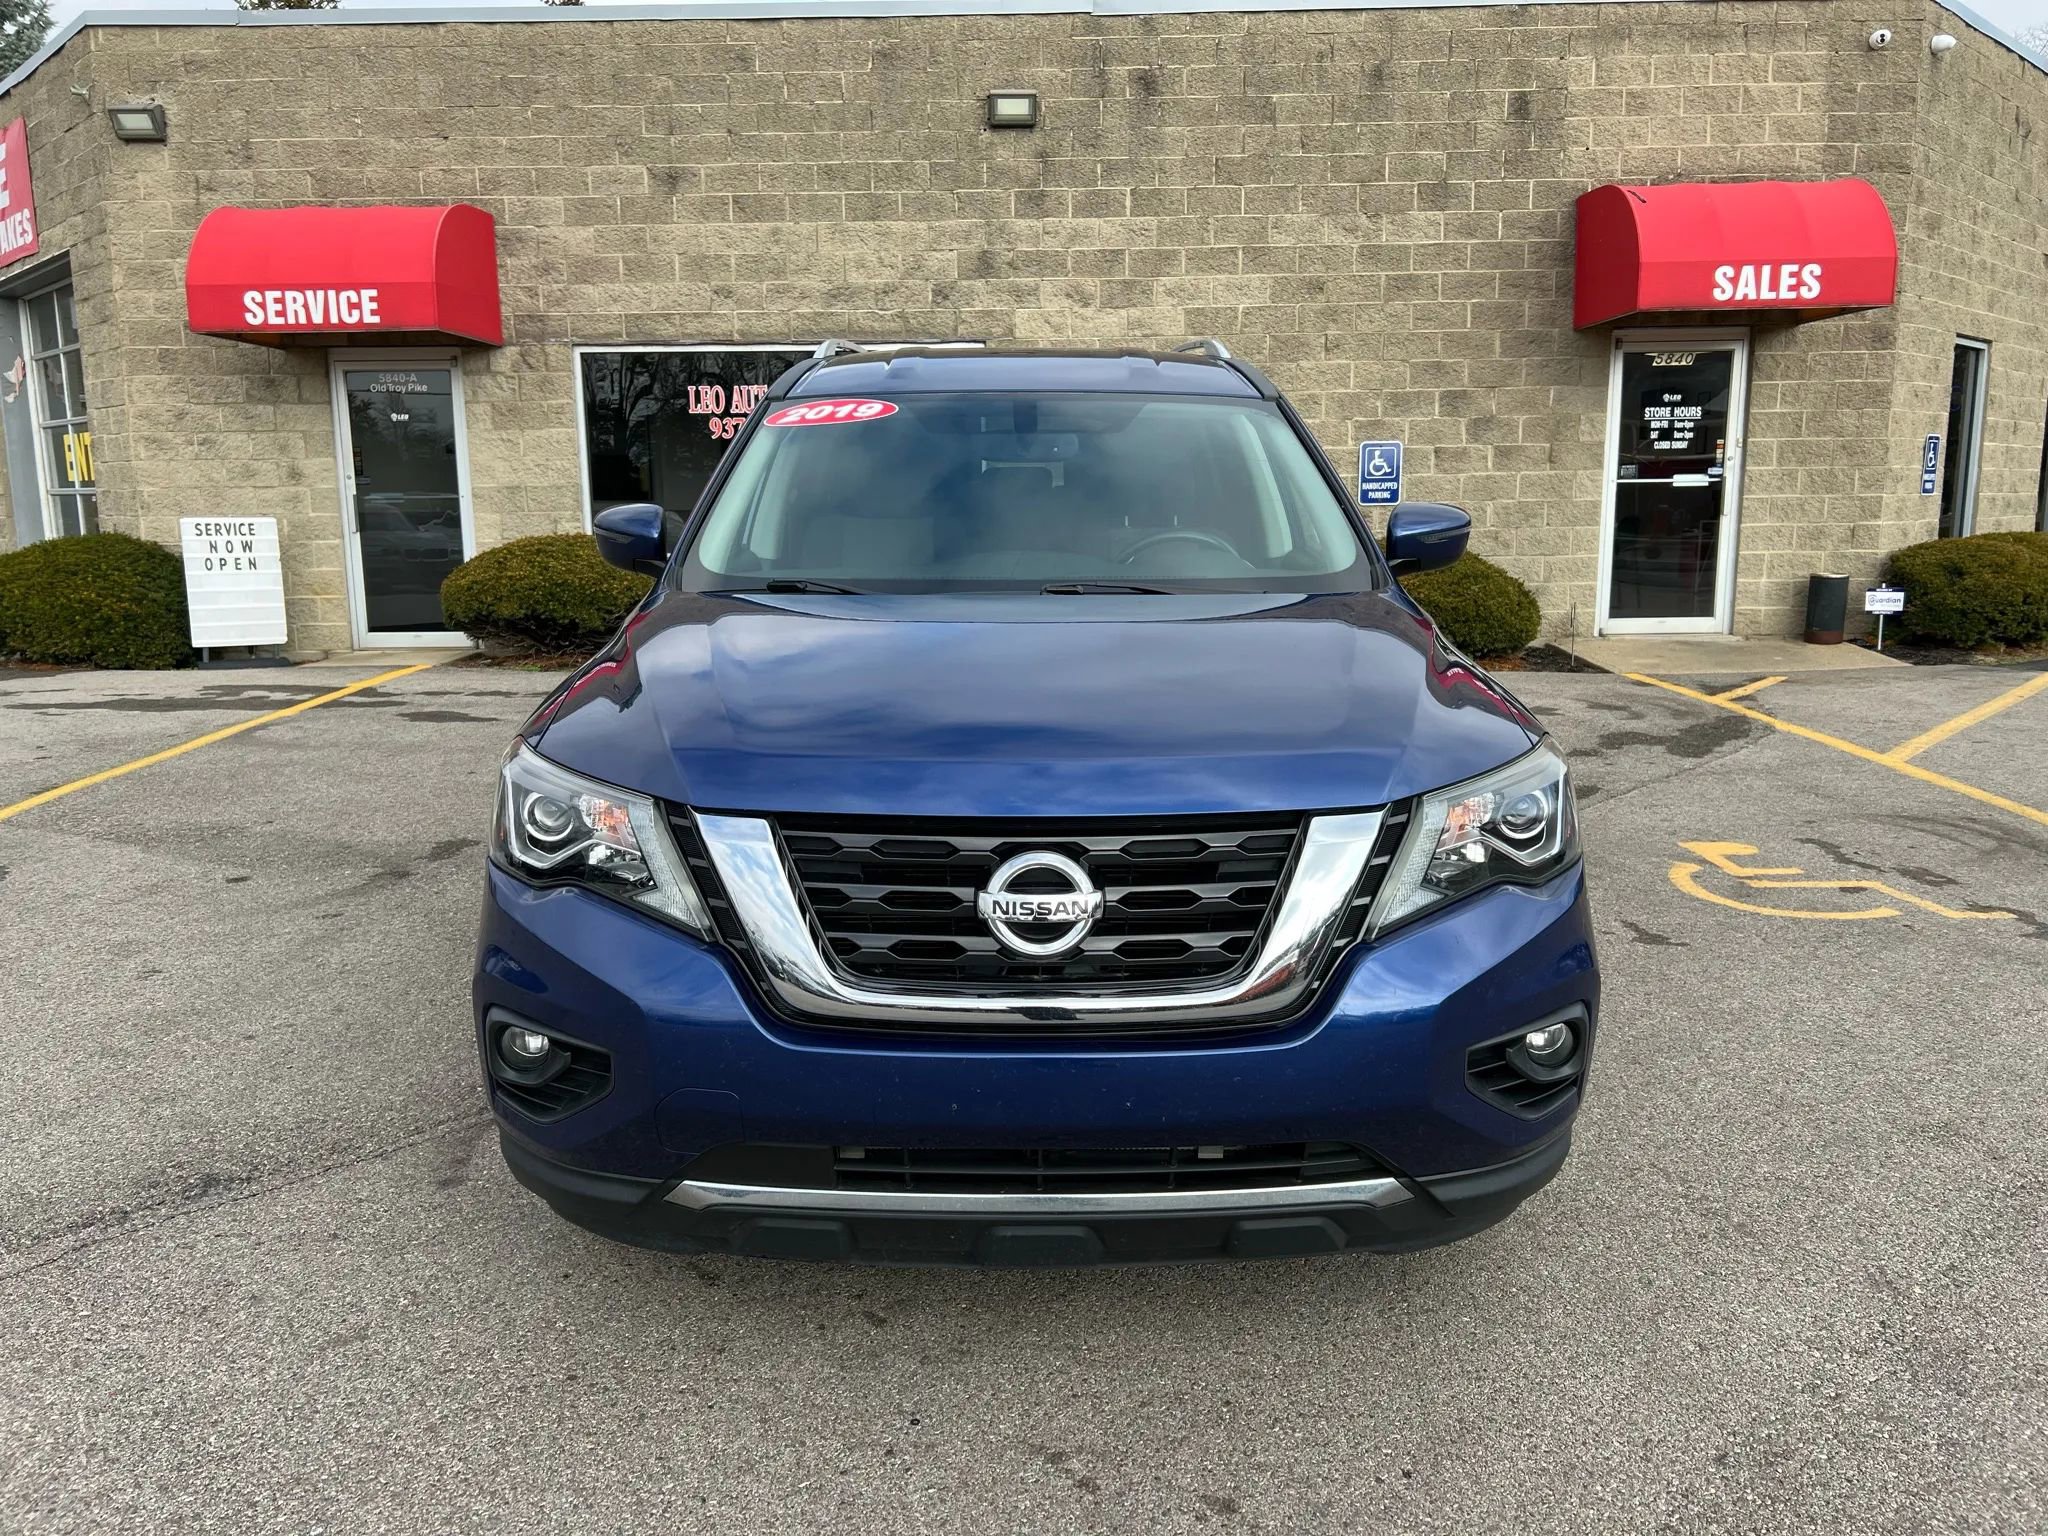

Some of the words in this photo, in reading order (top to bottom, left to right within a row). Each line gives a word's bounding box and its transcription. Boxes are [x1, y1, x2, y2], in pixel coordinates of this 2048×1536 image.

[1712, 263, 1823, 301] SALES
[243, 289, 381, 326] SERVICE
[1655, 353, 1695, 365] 5840
[379, 373, 418, 383] 5840-A
[370, 383, 386, 392] Old
[387, 383, 406, 394] Troy
[408, 383, 428, 392] Pike
[687, 385, 726, 414] LEO
[780, 402, 879, 424] 2019
[1644, 407, 1671, 418] STORE
[1674, 406, 1702, 417] HOURS
[1650, 430, 1659, 439] SAT
[1653, 441, 1671, 450] CLOSED
[1671, 440, 1689, 450] SUNDAY
[1362, 482, 1397, 490] HANDICAPPED
[1368, 491, 1391, 499] PARKING
[194, 522, 256, 537] SERVICE
[209, 540, 253, 554] NOW
[204, 557, 257, 571] OPEN
[992, 900, 1089, 917] NISSAN
